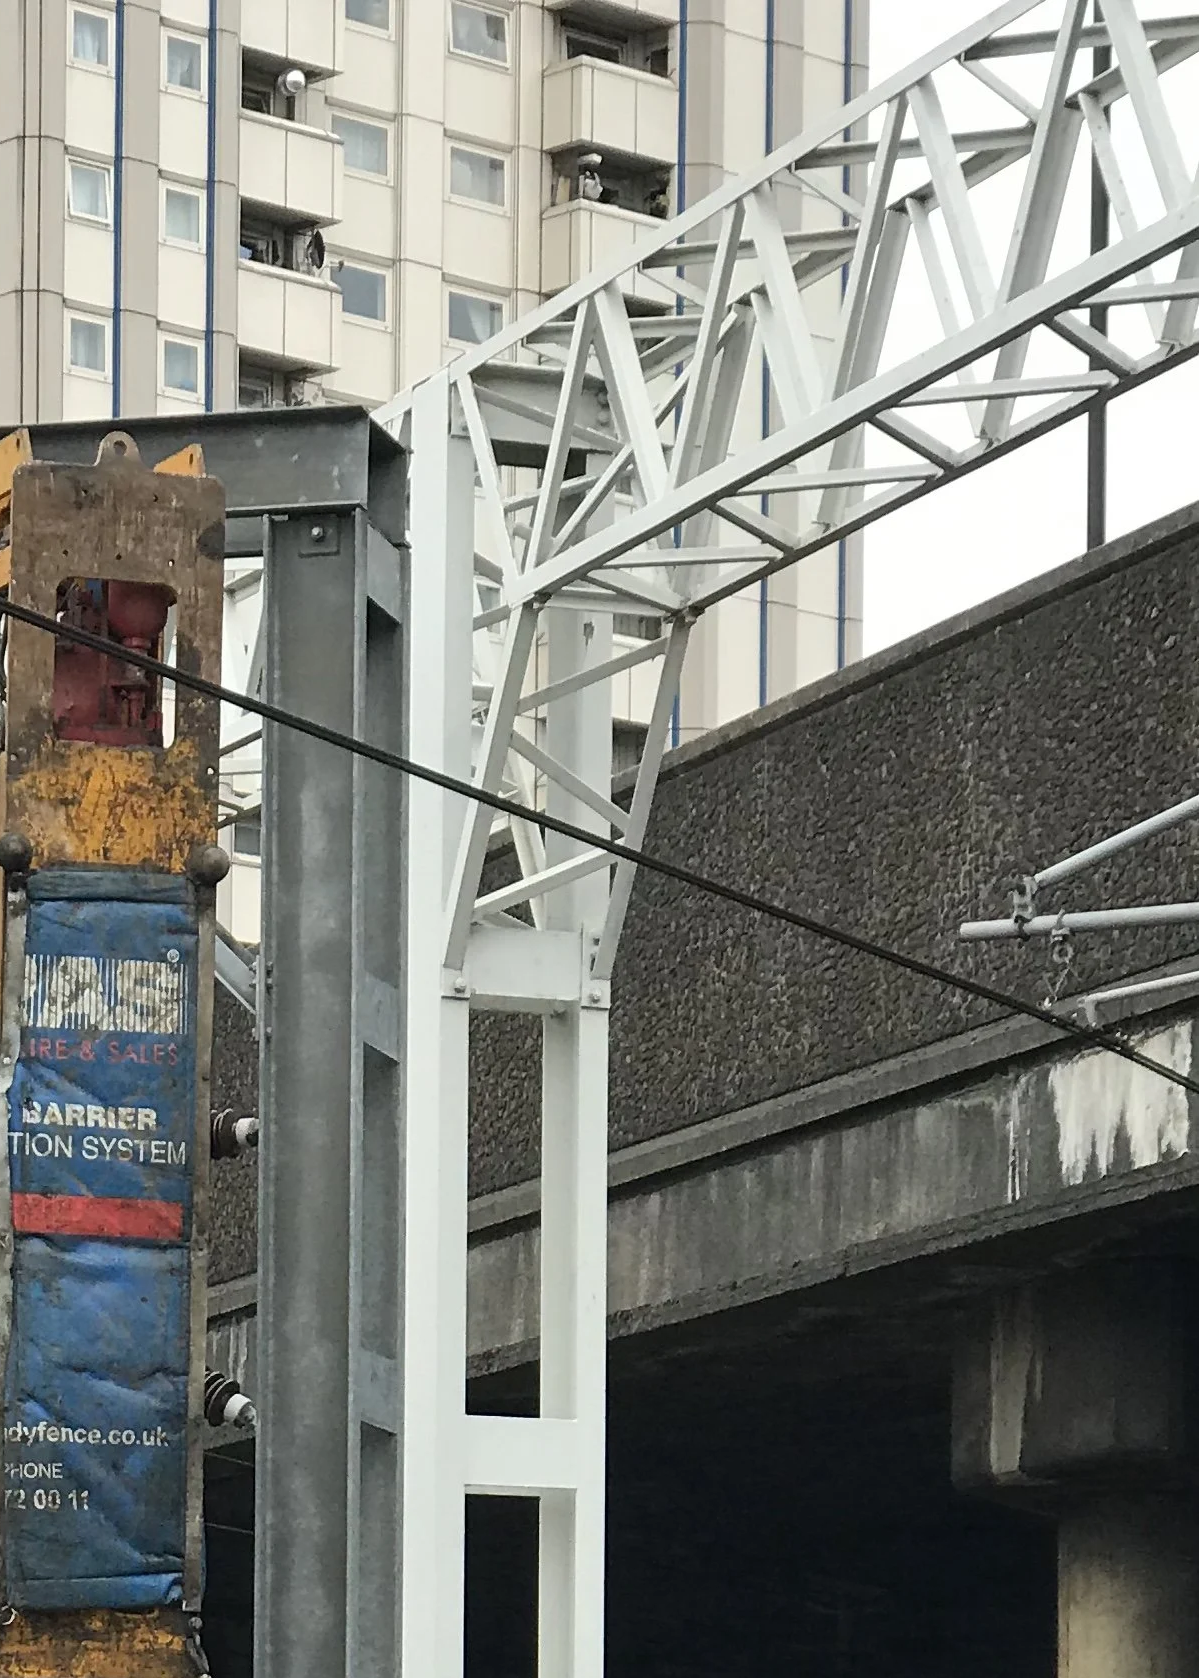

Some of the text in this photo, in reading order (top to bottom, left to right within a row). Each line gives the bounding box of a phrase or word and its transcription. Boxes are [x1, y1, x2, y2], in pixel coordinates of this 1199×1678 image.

[23, 1037, 179, 1067] IRE & SALES
[22, 1100, 158, 1132] BARRIER
[82, 1135, 186, 1165] SYSTEM
[4, 1421, 169, 1448] dyfence.co.uk
